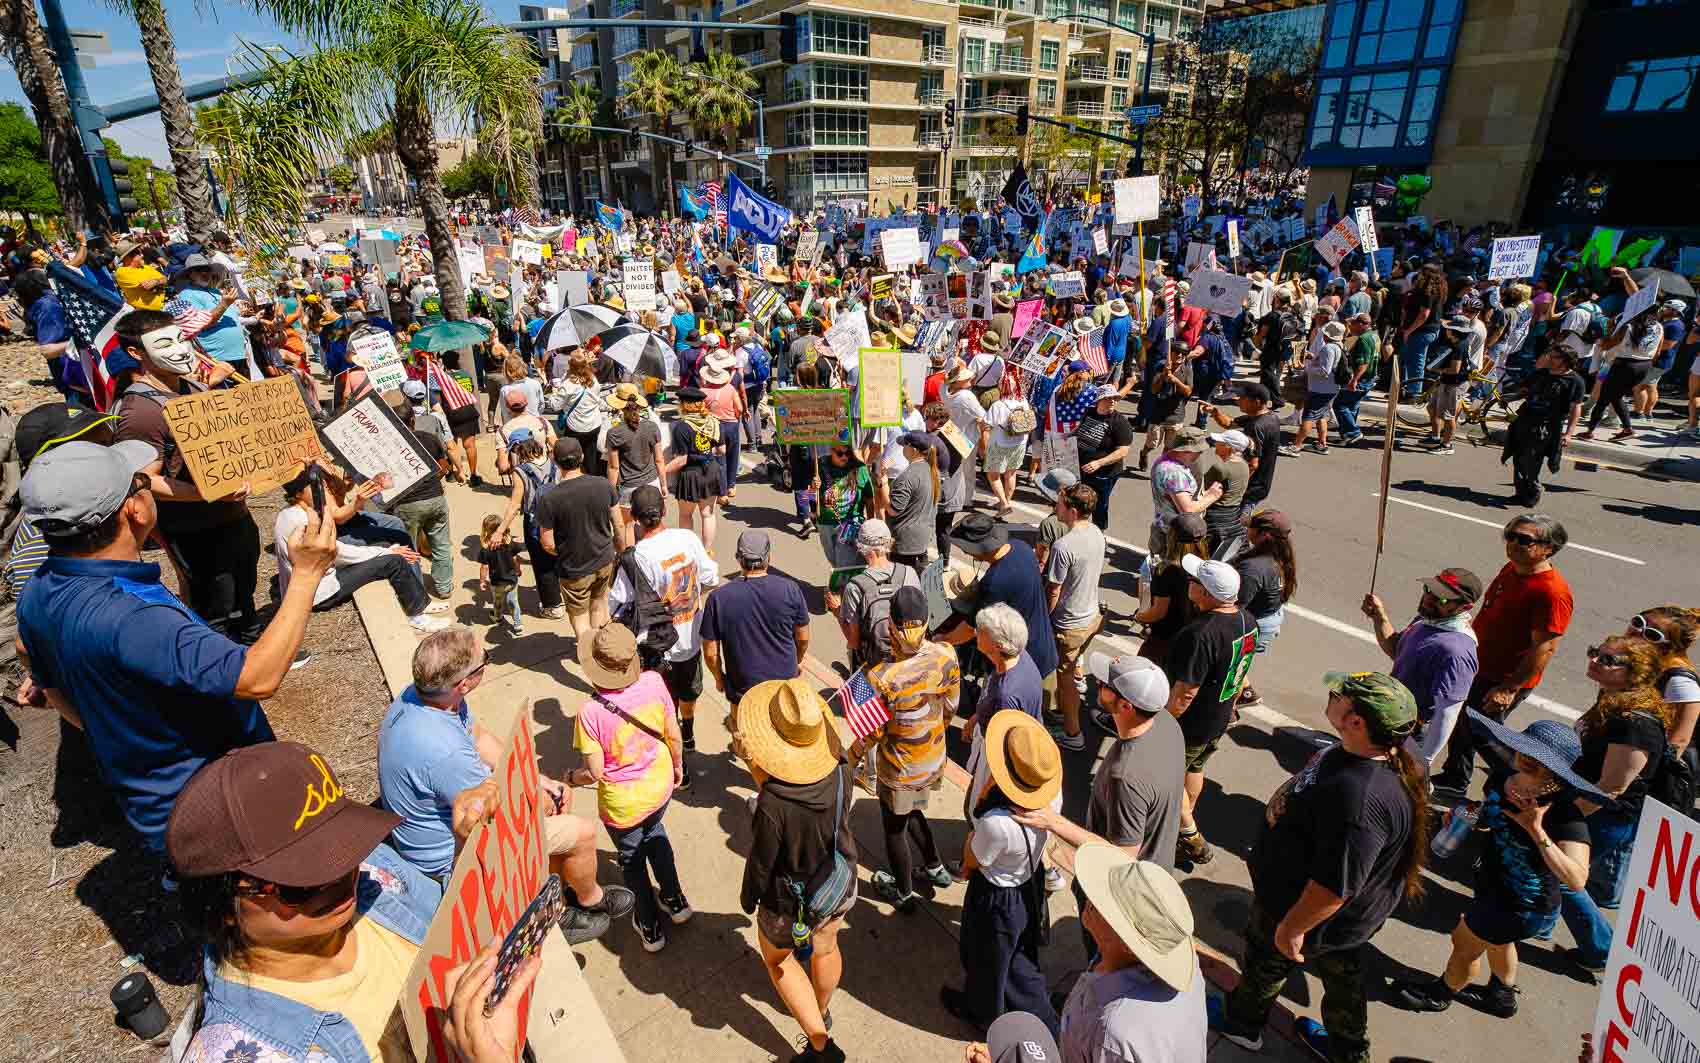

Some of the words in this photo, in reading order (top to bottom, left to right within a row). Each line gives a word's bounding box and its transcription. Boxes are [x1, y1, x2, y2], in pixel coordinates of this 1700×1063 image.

[1511, 263, 1531, 276] LADY
[164, 400, 197, 421] LET
[202, 394, 229, 412] ME
[232, 388, 251, 408] SAY
[265, 383, 284, 398] RISK
[175, 410, 249, 443] SOUNDING
[250, 397, 306, 423] RIDICULOUS
[351, 406, 380, 435] TRUMP
[184, 443, 217, 467] THE
[216, 434, 255, 460] TRUE
[254, 416, 314, 448] REVOLUTIONARY
[201, 467, 220, 489] IS
[221, 451, 275, 481] GUIDED
[288, 439, 318, 465] LOVE
[400, 447, 425, 475] FUCK
